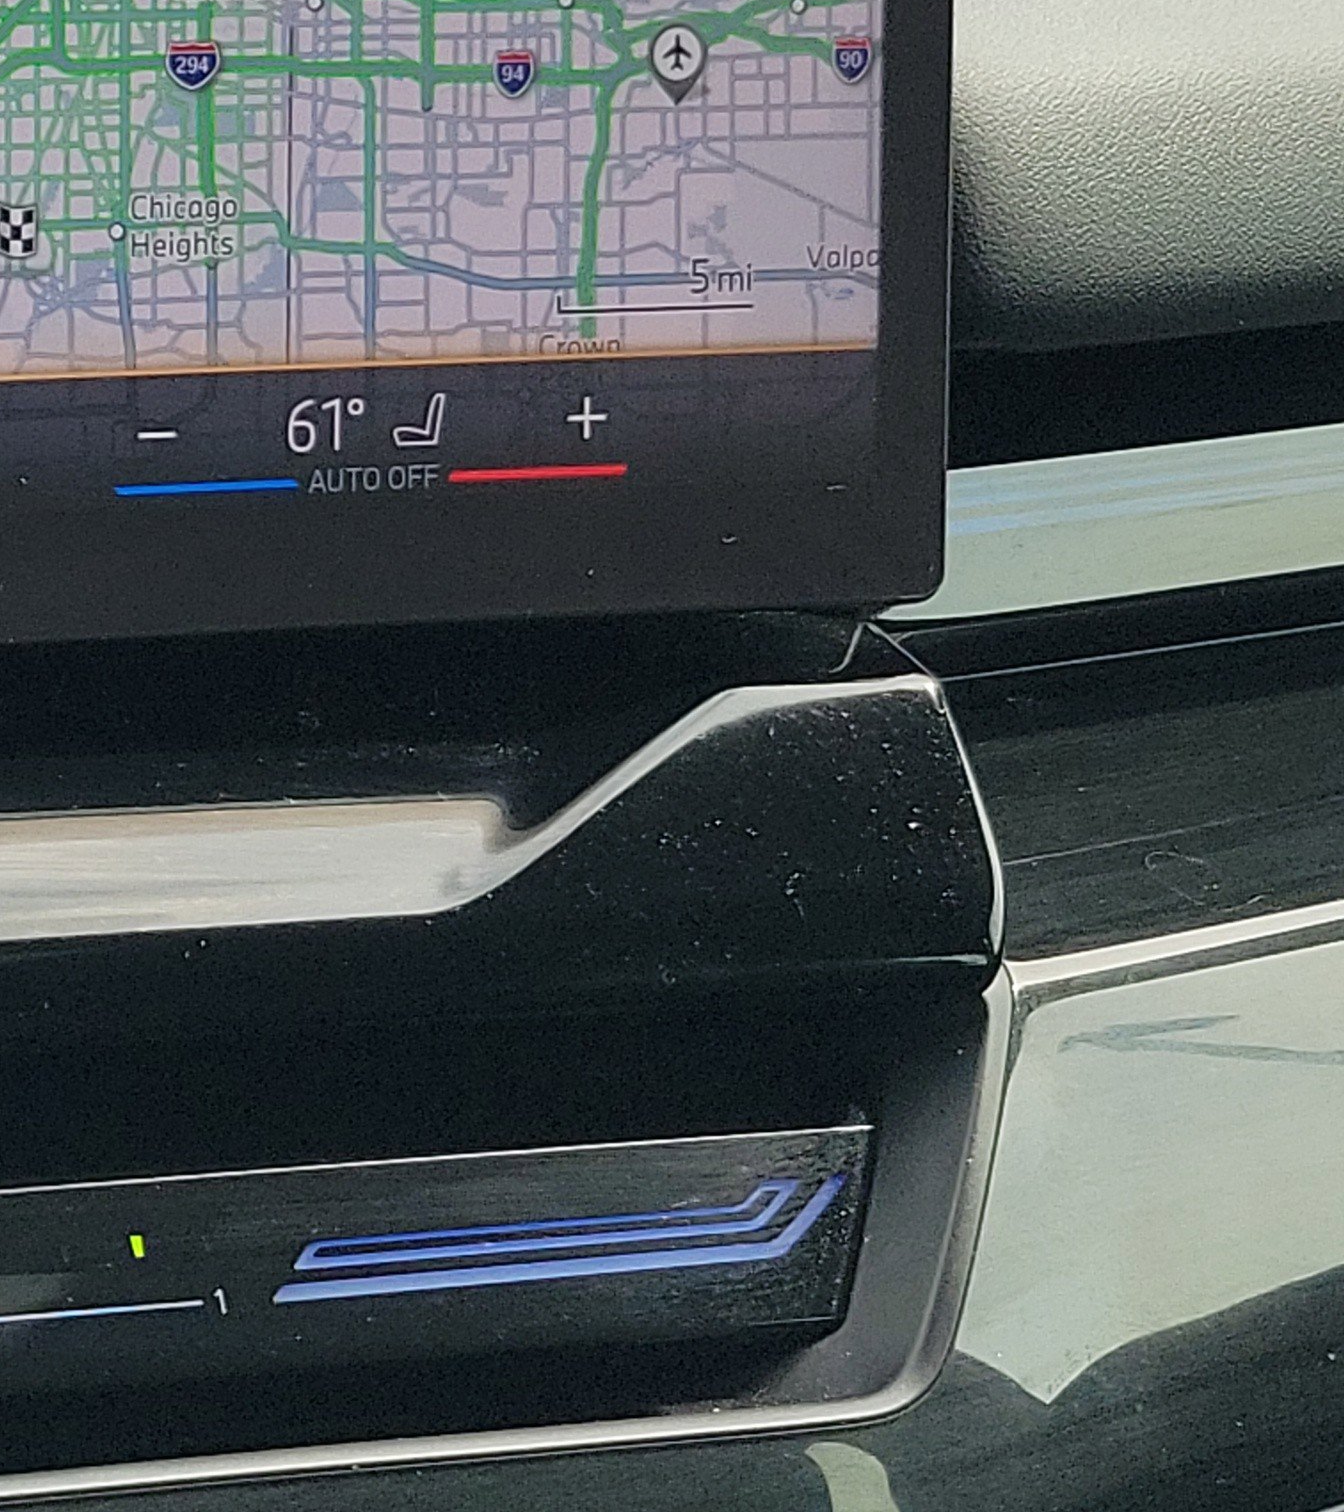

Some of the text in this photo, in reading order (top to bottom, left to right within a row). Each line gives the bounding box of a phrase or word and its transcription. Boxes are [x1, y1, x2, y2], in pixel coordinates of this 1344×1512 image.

[175, 55, 209, 74] 294
[840, 51, 862, 68] 90
[500, 64, 525, 83] 94
[131, 195, 238, 224] Chicago
[131, 233, 234, 259] Heights
[690, 260, 753, 293] 5 mi
[309, 464, 439, 493] AUTO OFF
[213, 1287, 227, 1317] 1
